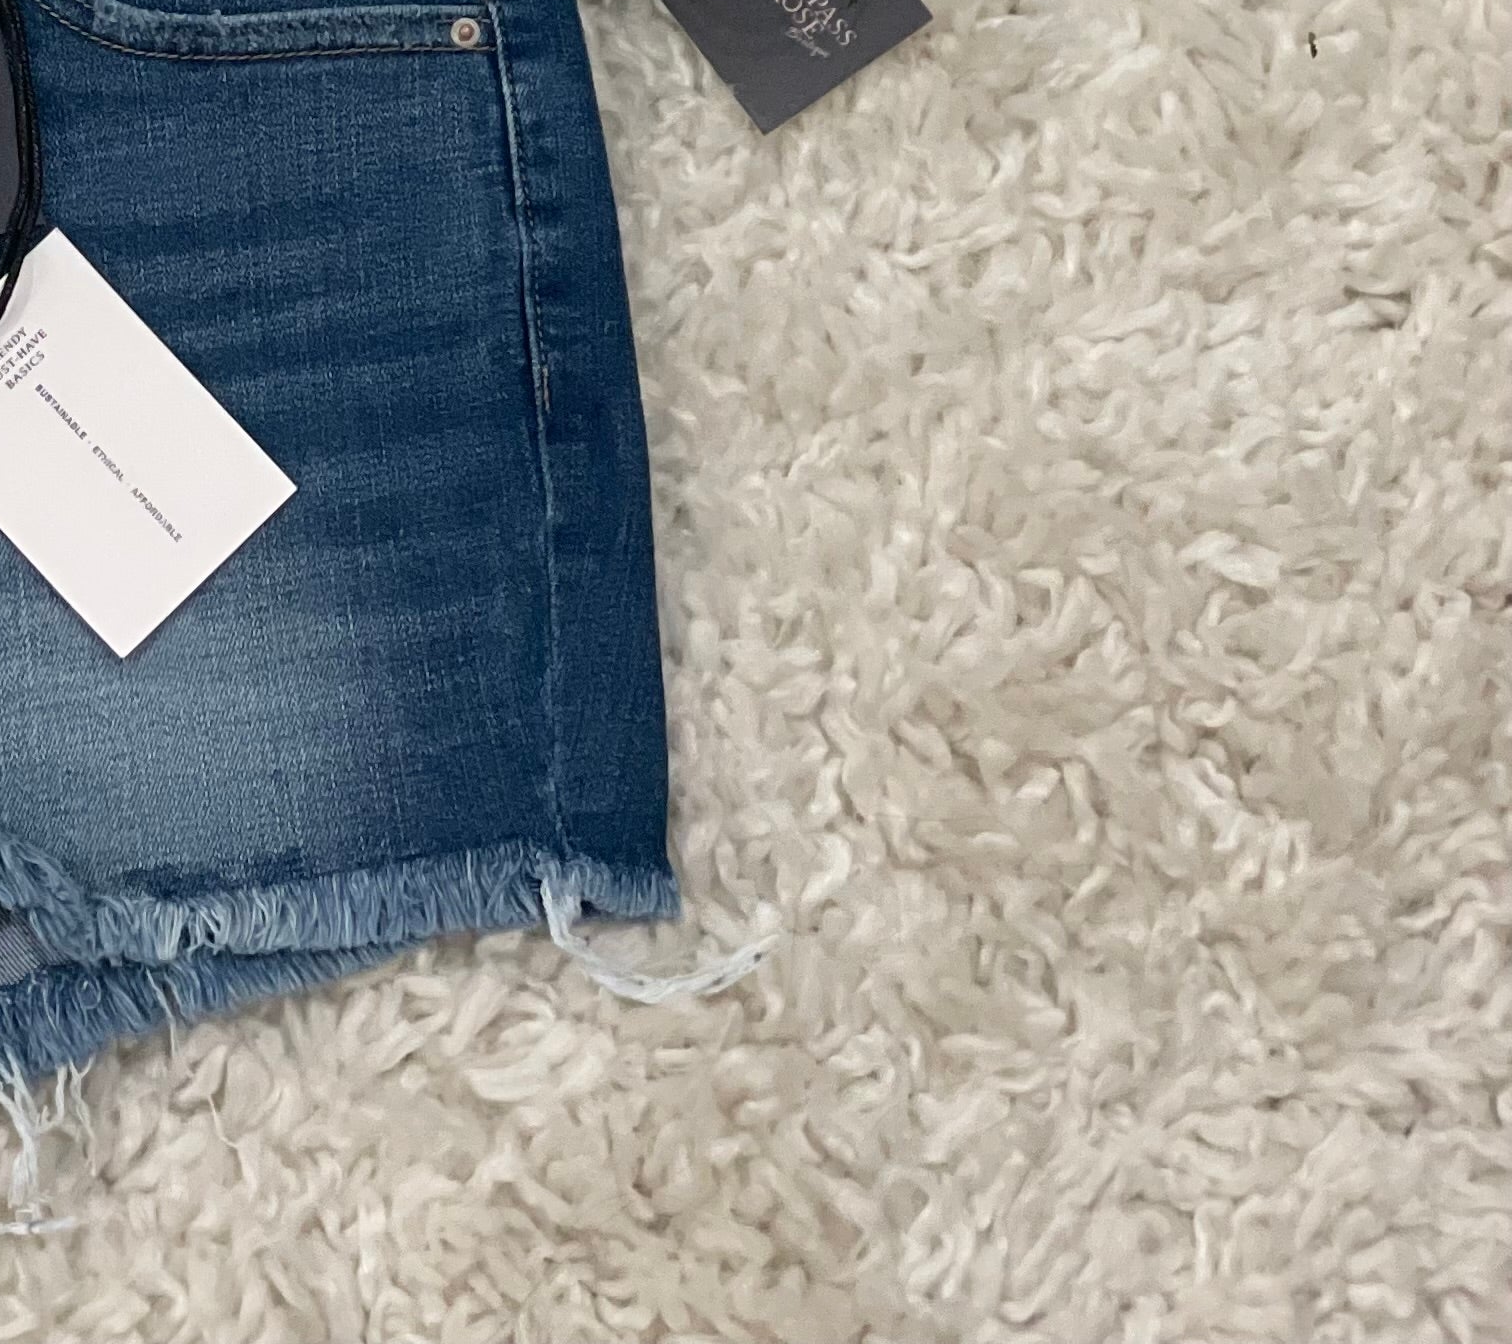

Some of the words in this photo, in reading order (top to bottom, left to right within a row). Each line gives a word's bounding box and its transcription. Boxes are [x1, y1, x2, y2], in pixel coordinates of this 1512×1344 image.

[4, 350, 45, 390] BASICS
[34, 383, 88, 440] SUSTAINABLE
[92, 445, 125, 483] ETHICAL
[131, 487, 183, 543] AFFORDABLE
